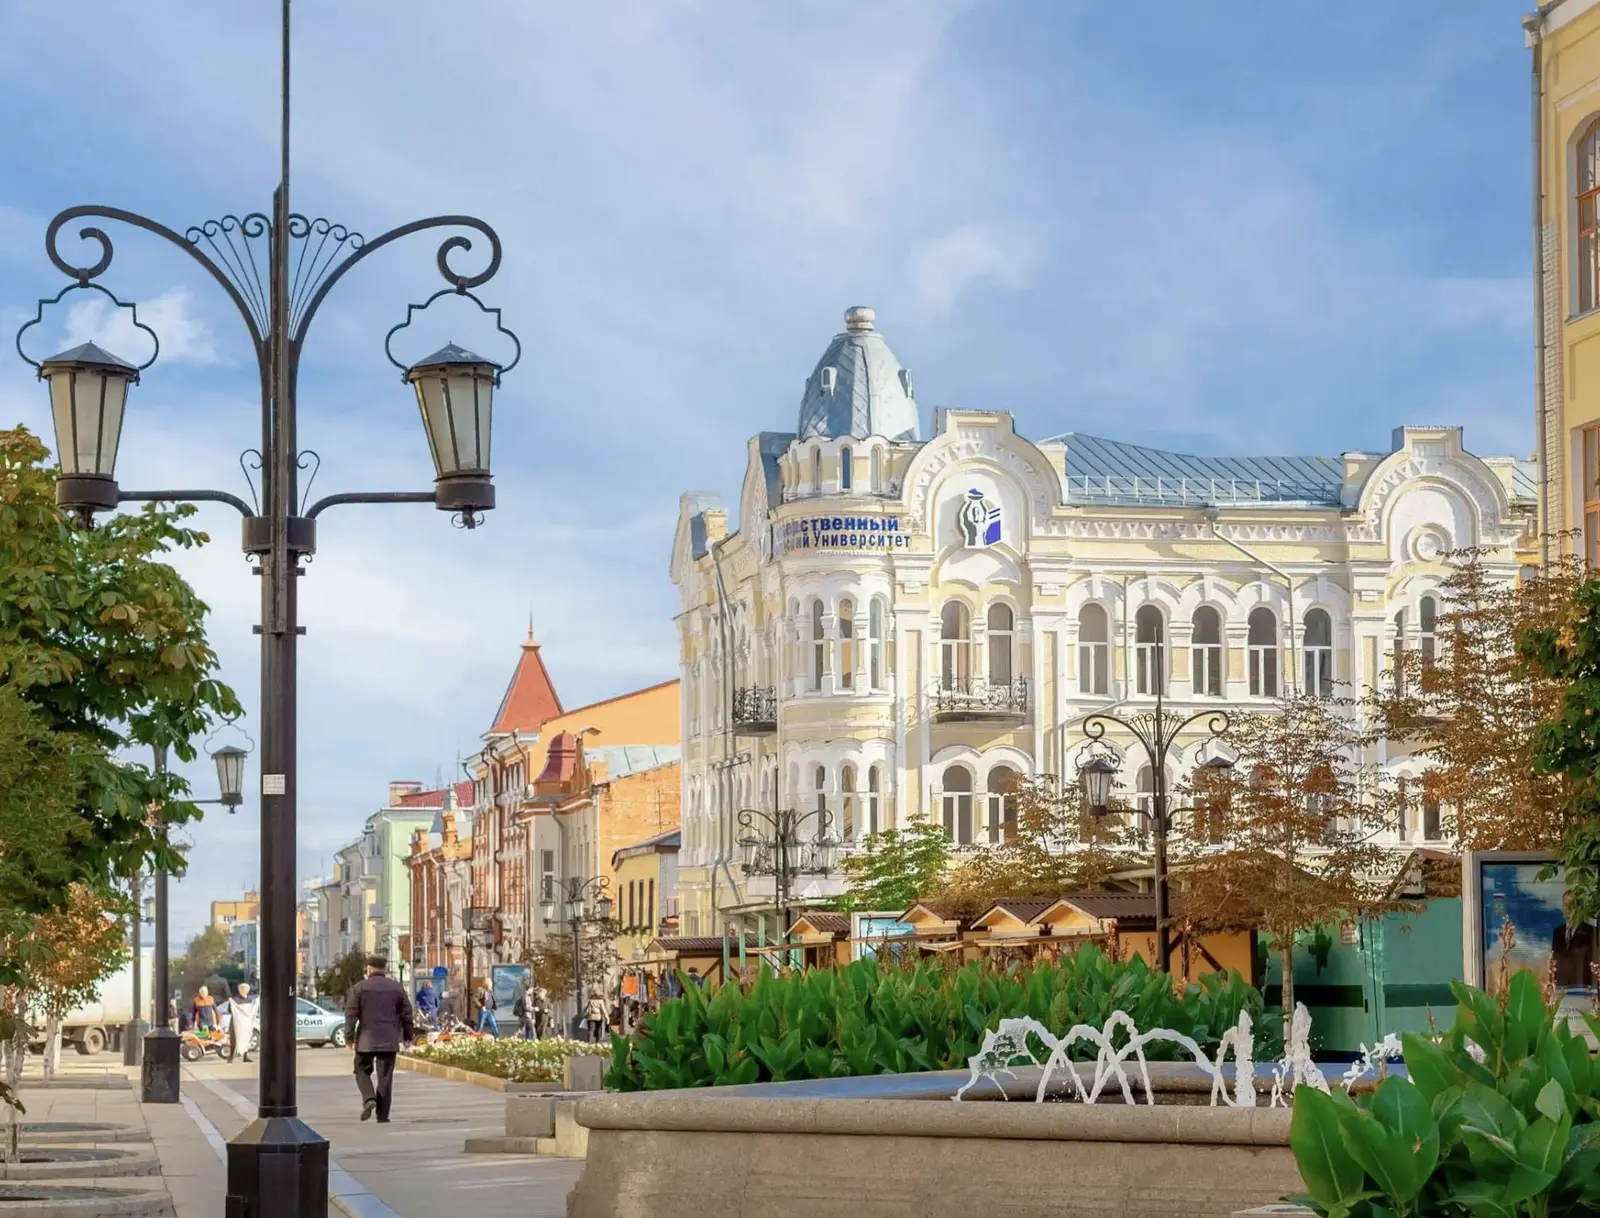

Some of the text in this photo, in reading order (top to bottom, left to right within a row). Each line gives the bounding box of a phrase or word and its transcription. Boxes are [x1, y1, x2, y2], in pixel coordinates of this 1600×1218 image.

[784, 516, 899, 533] ственный
[813, 531, 911, 548] Университет
[296, 1017, 323, 1026] обил
